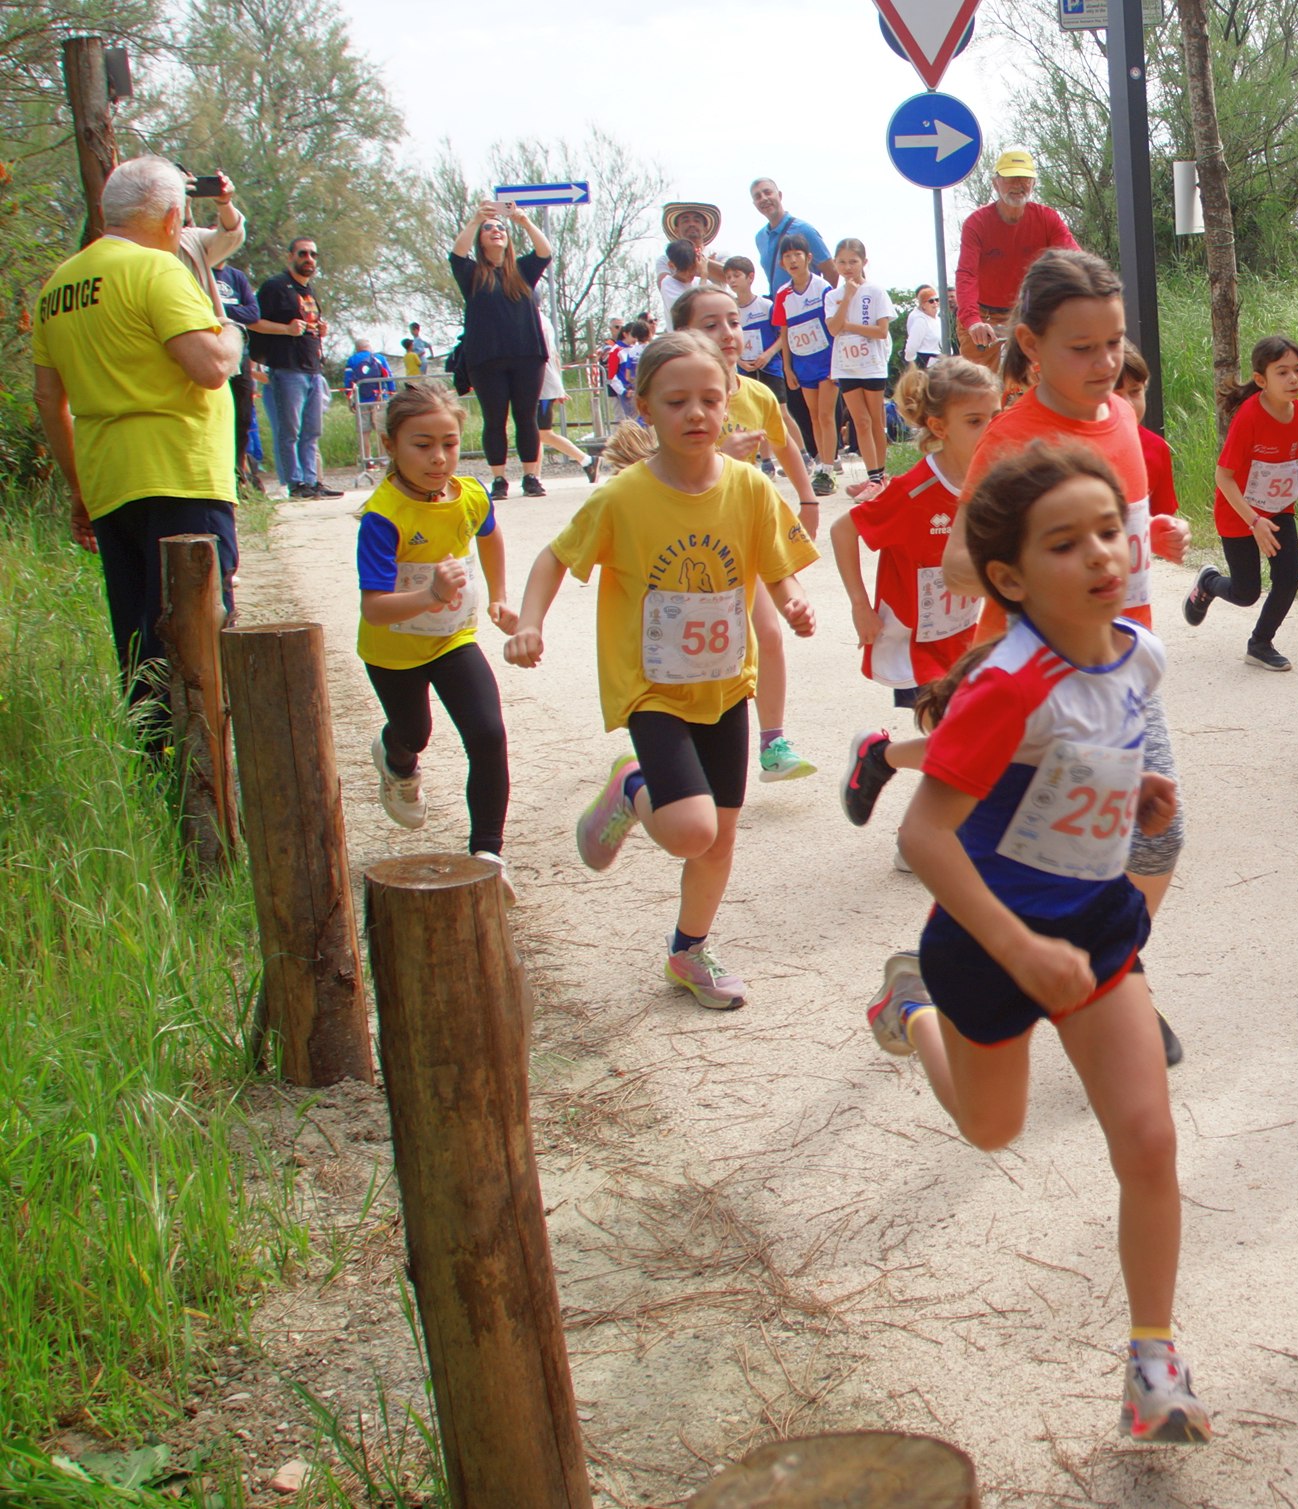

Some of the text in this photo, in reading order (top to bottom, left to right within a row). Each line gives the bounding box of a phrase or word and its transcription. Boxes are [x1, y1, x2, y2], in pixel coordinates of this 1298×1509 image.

[41, 277, 102, 324] GIUDICE
[793, 330, 818, 348] 201
[843, 343, 870, 359] 105
[1267, 478, 1294, 498] 52
[681, 620, 730, 656] 58
